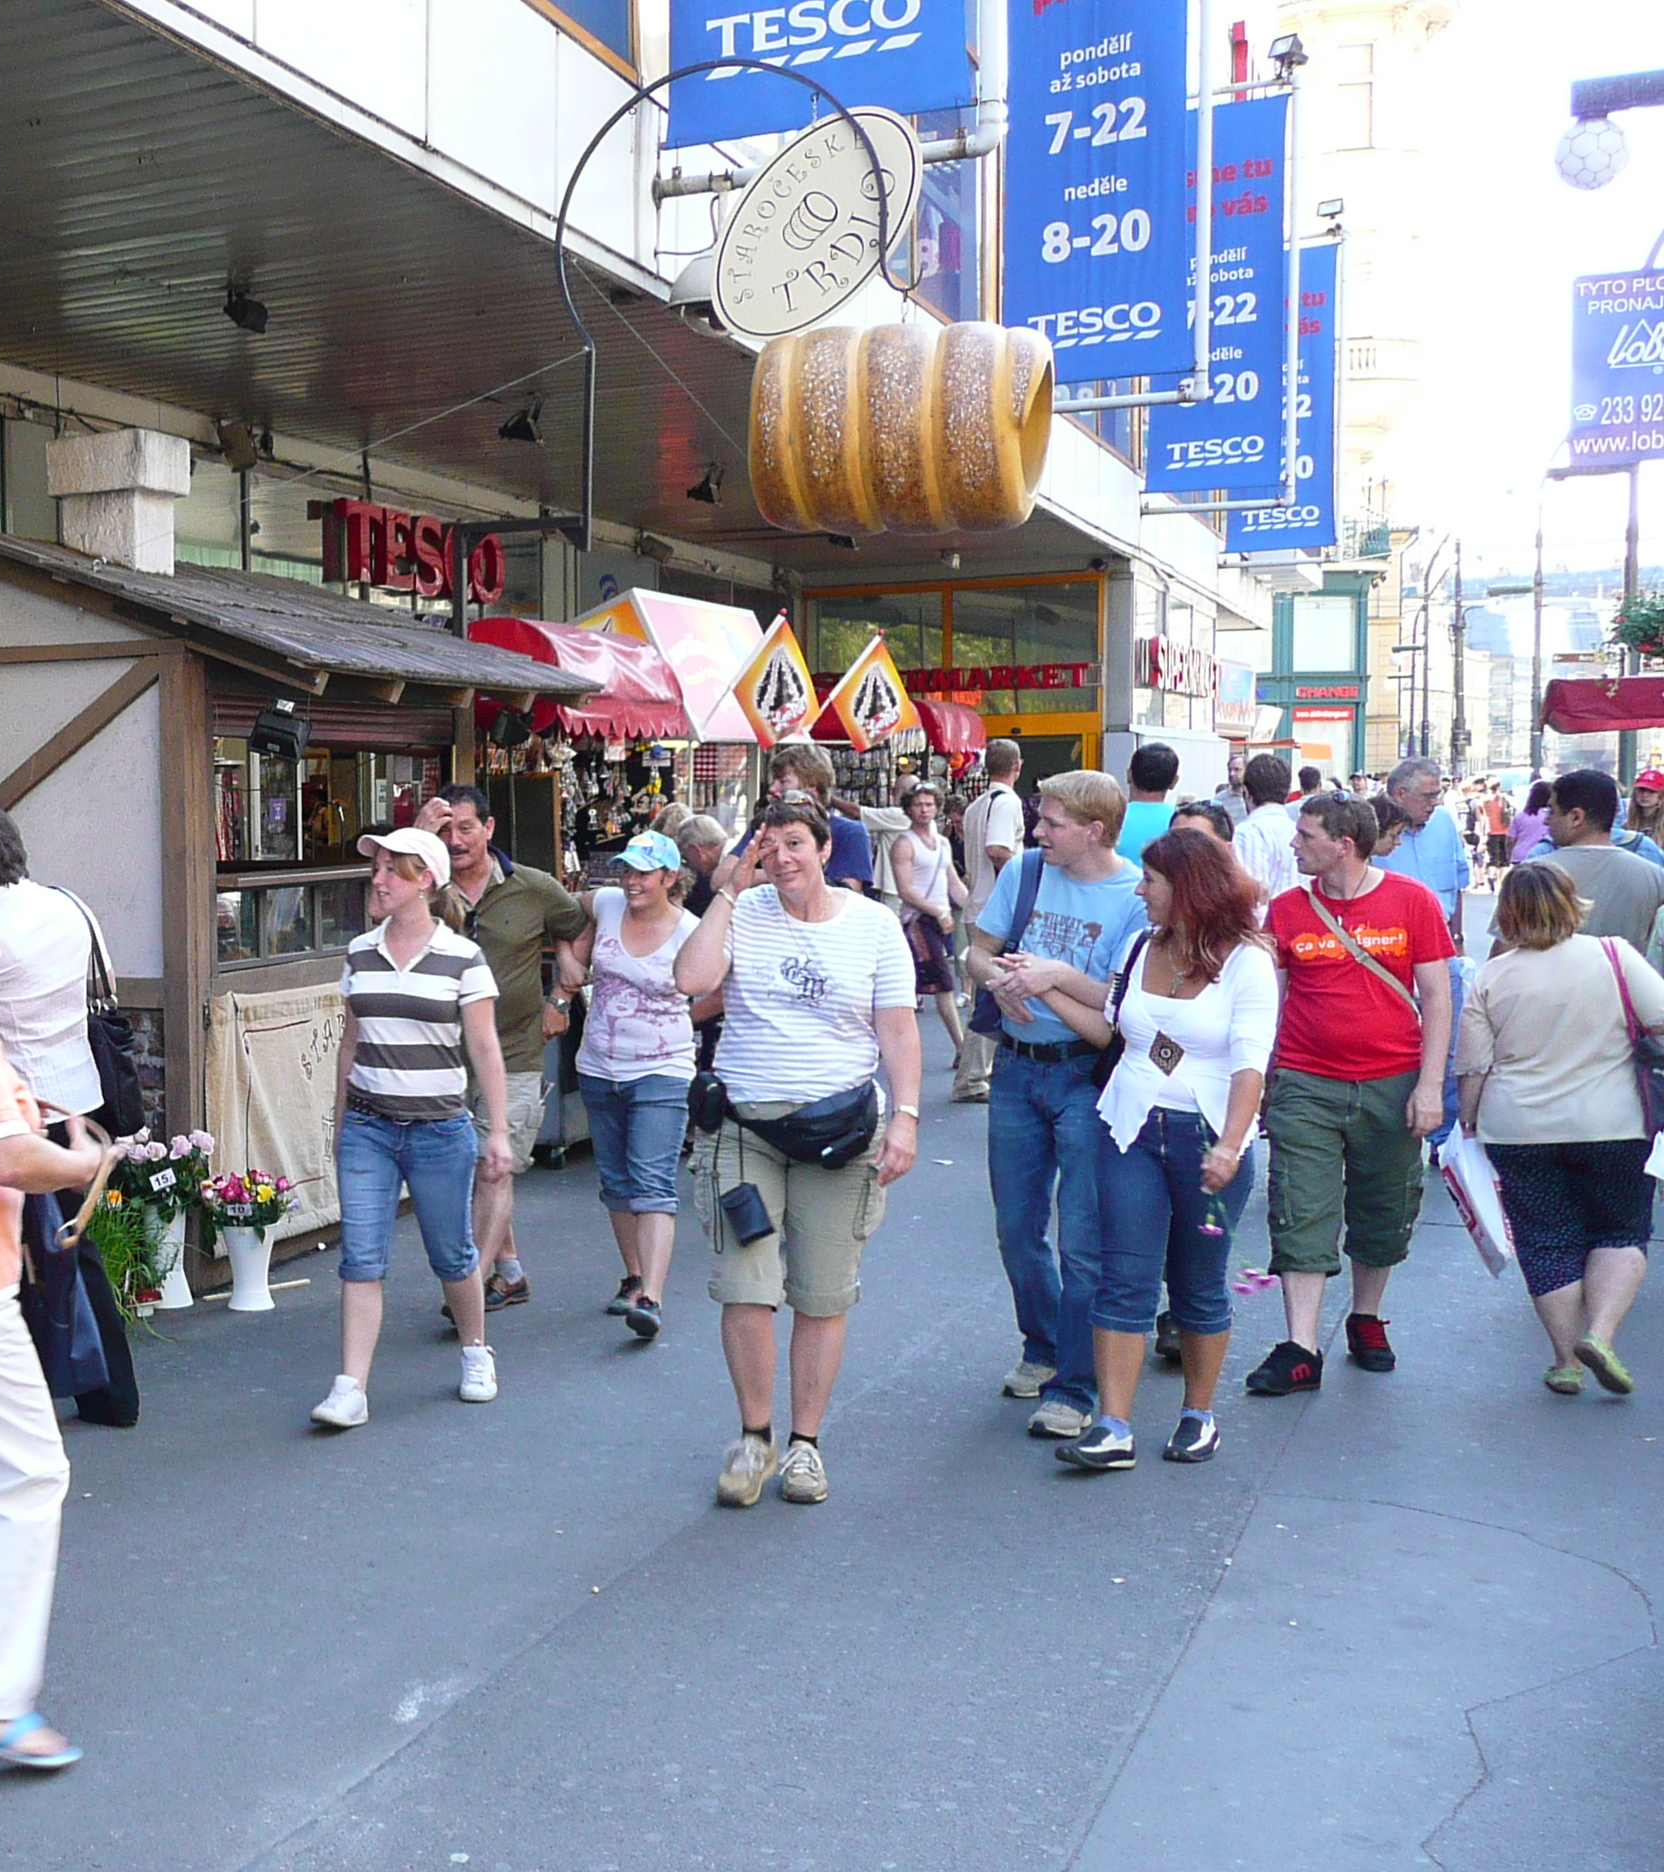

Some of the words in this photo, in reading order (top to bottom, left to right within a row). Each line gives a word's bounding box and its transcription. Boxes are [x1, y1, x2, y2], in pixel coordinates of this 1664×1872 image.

[706, 0, 921, 57] TESCO
[1060, 31, 1134, 70] pondělí
[1050, 72, 1073, 94] až
[1076, 62, 1142, 88] sobota
[1044, 96, 1148, 155] 7-22
[1243, 158, 1273, 179] tu
[1064, 175, 1128, 201] neděle
[1221, 190, 1268, 217] vás
[1041, 208, 1151, 264] 8-20
[1190, 247, 1247, 271] pndělí
[1210, 267, 1254, 283] obota
[1576, 280, 1626, 297] TYTO
[1588, 295, 1664, 315] PRONAJ
[1027, 301, 1162, 337] TESCO
[1600, 395, 1635, 425] 233
[1641, 393, 1664, 422] 92
[1166, 435, 1265, 460] TESCO
[1241, 505, 1320, 525] TESCO
[1296, 686, 1360, 699] CHANGE
